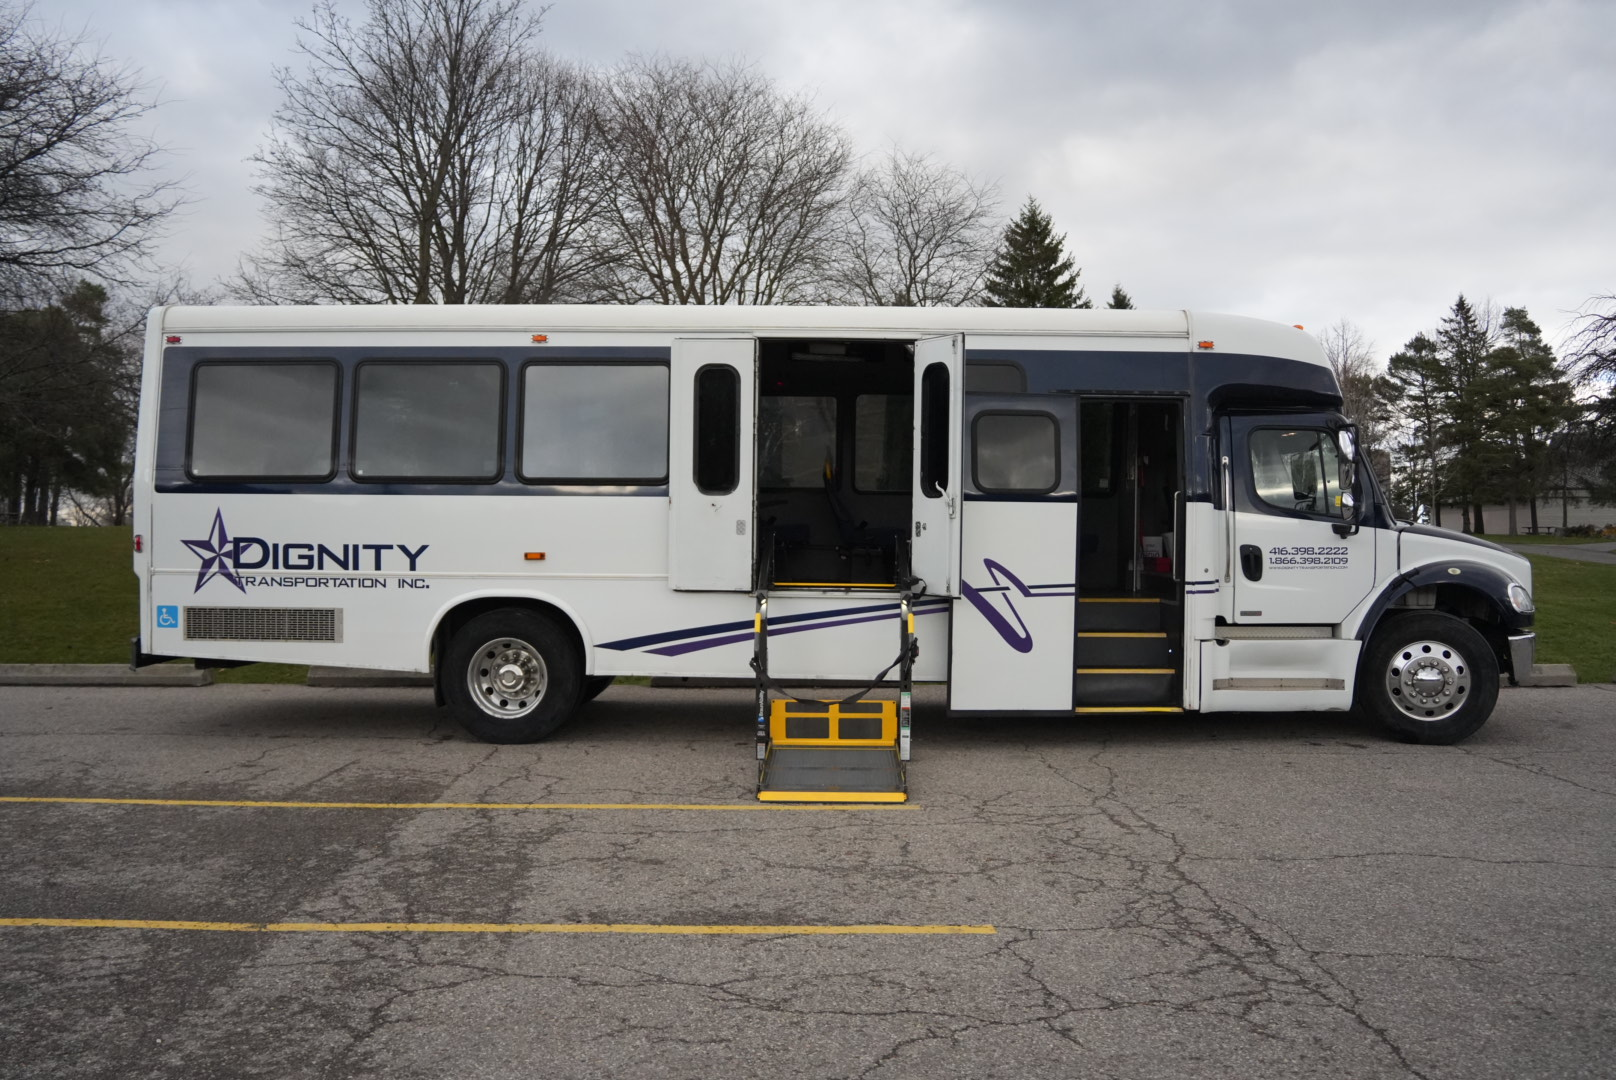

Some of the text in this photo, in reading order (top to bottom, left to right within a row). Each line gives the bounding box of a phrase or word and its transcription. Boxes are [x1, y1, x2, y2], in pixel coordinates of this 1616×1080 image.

[233, 537, 430, 571] DIGNITY
[1269, 547, 1348, 555] 416.398.2222
[235, 576, 430, 589] TRANSPORTATION INC.
